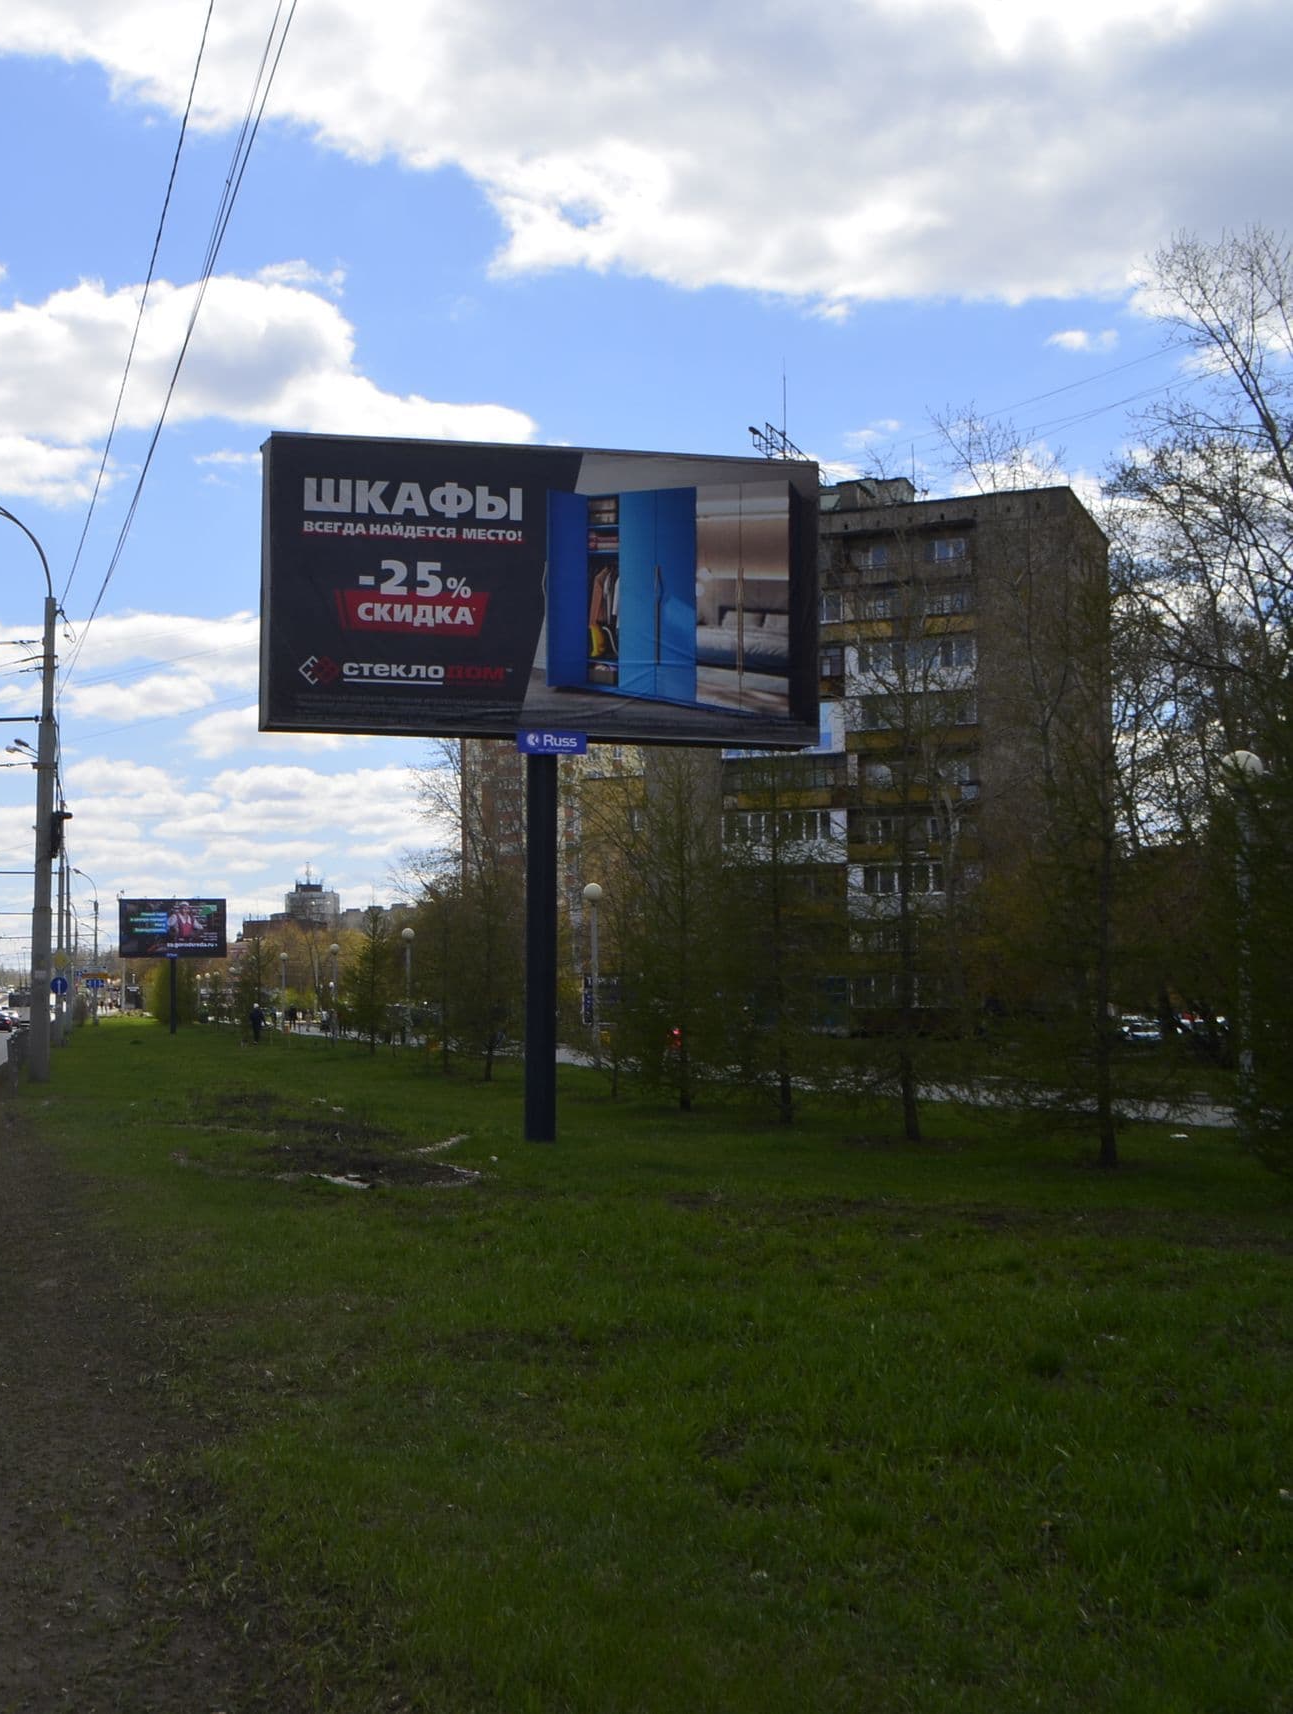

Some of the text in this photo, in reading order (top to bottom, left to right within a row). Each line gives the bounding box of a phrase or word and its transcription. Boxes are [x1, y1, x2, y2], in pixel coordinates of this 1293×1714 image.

[303, 477, 523, 521] ШКАФЫ
[303, 520, 523, 542] ВСЕГДА НАЙДЕТСЯ МЕСТО!
[358, 559, 472, 599] -25%
[542, 734, 578, 748] Russ
